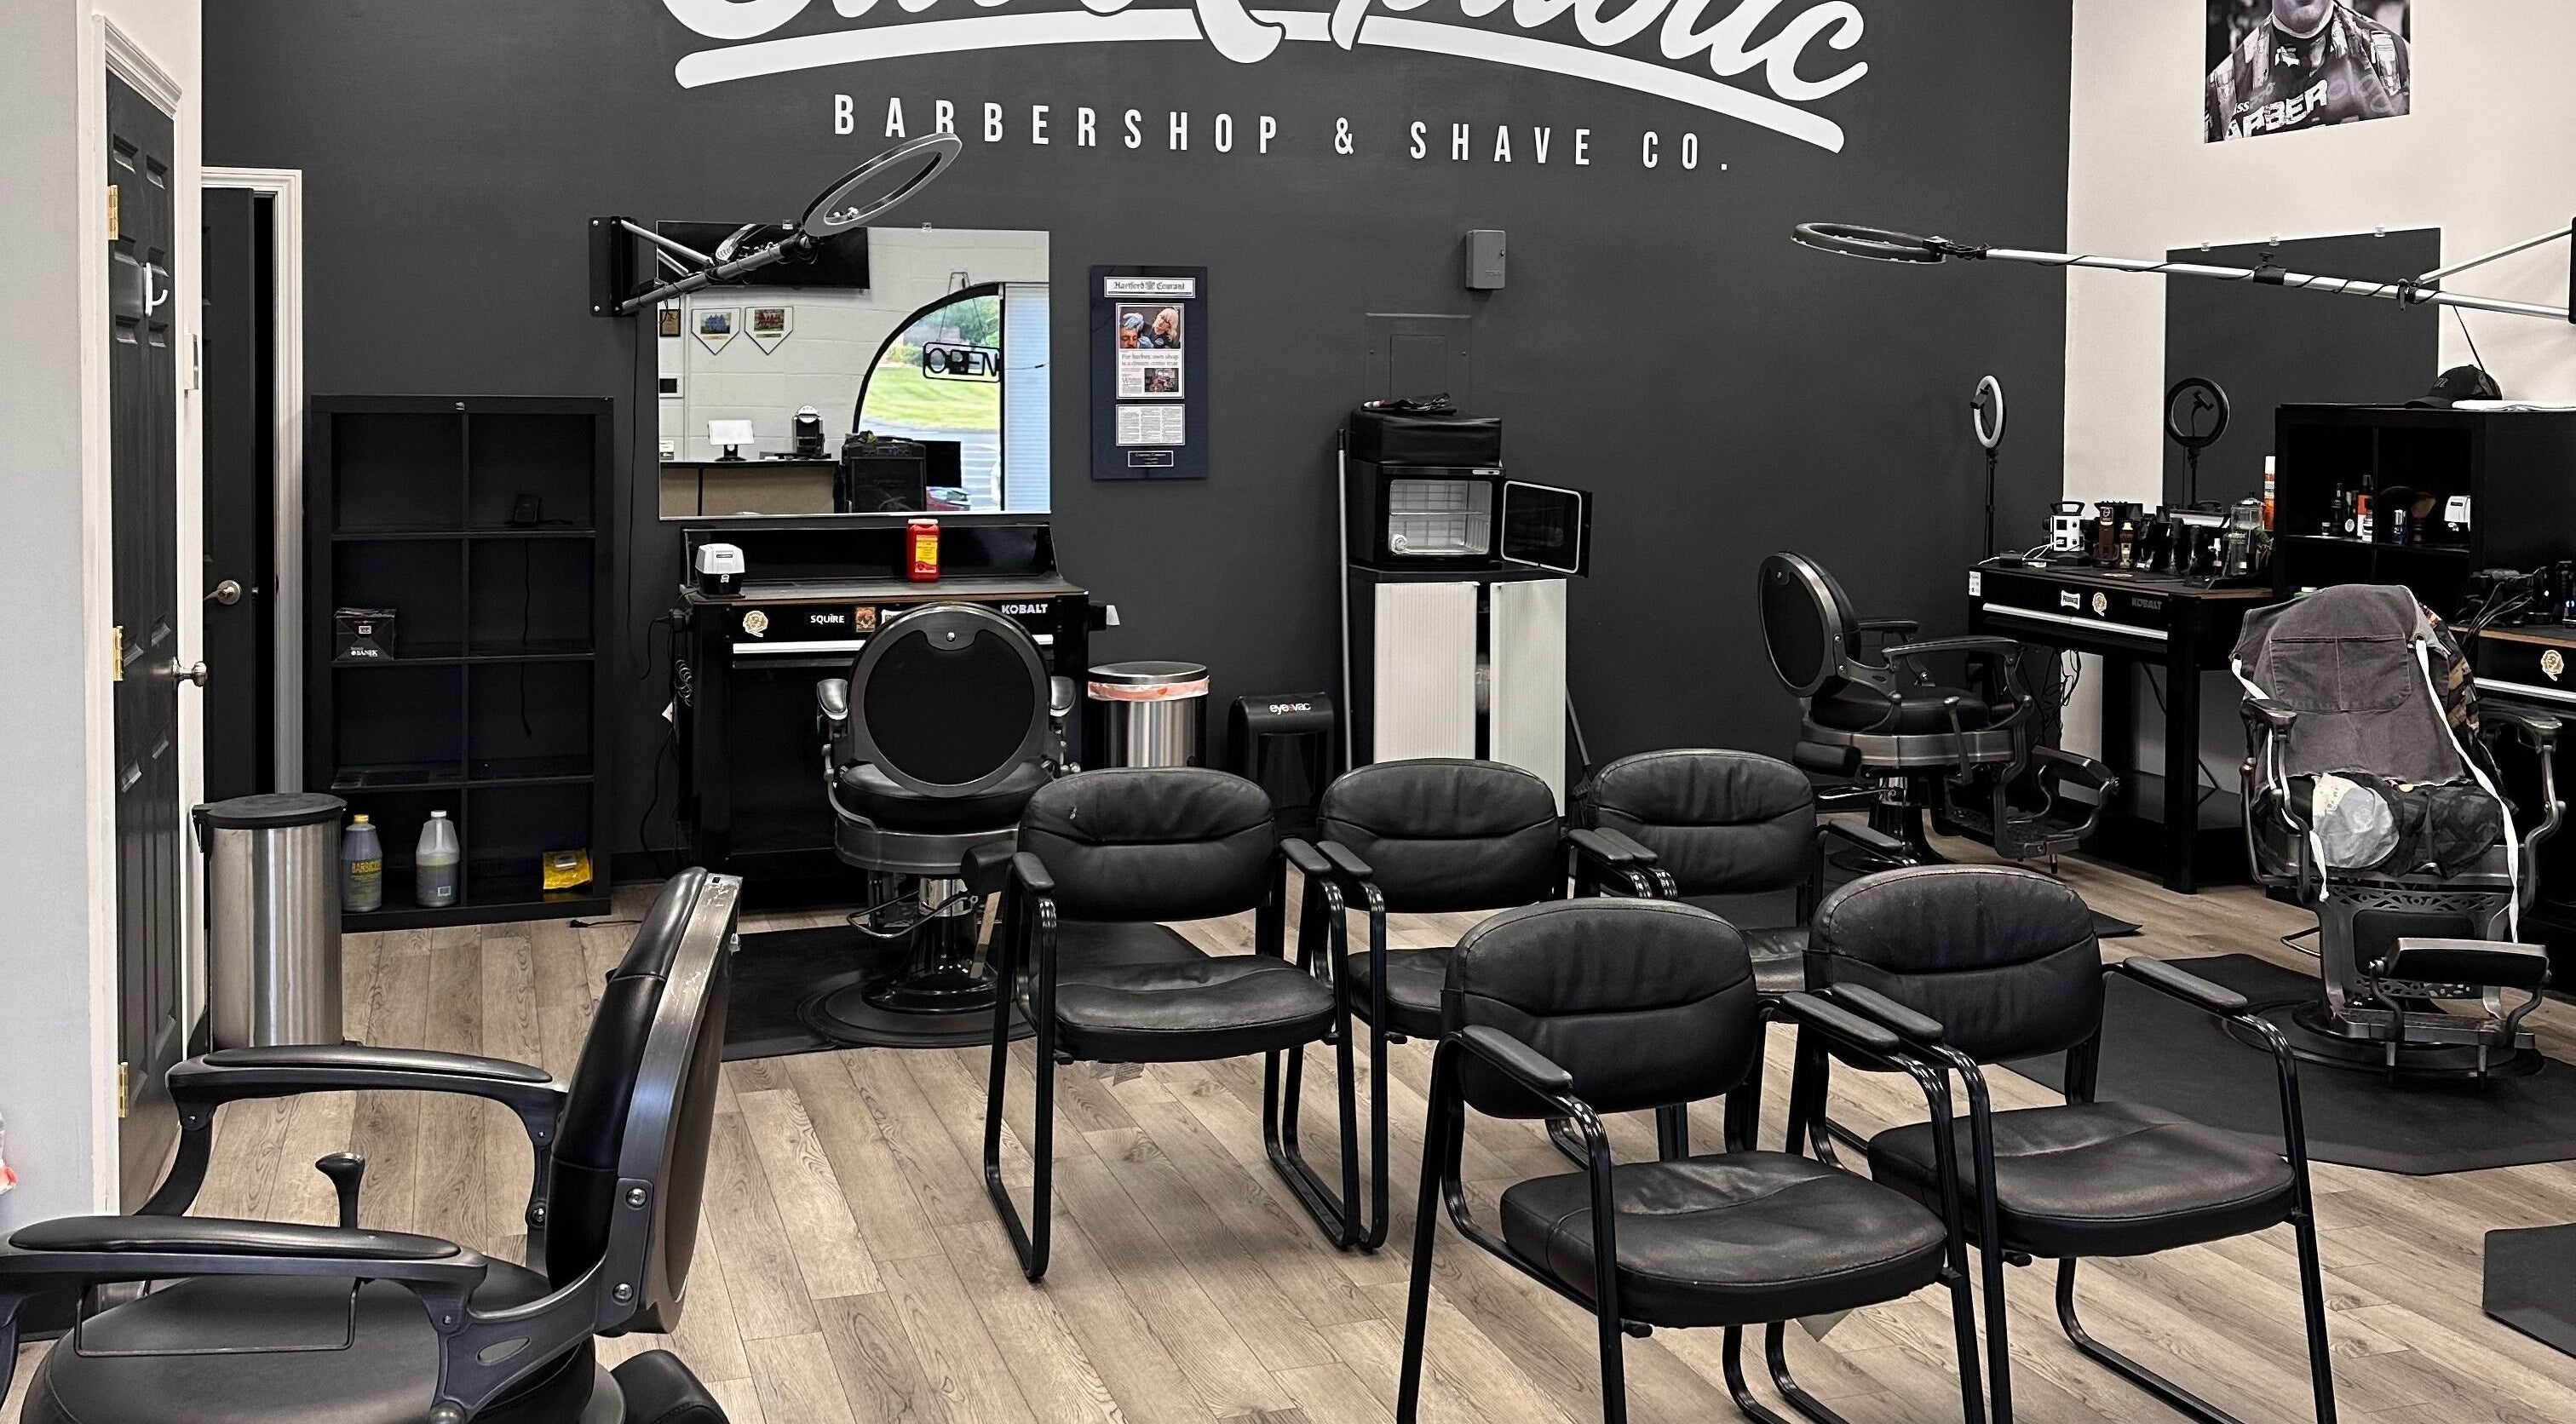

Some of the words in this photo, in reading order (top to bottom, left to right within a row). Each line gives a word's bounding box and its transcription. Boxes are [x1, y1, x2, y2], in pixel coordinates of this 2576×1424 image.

[834, 94, 1277, 154] BARBERSHOP
[1334, 117, 1354, 155] &
[1410, 121, 1590, 165] SHAVE
[1642, 131, 1728, 170] CO.
[929, 347, 998, 376] OPEN
[1001, 603, 1049, 615] KOBALT
[2131, 597, 2163, 611] KOBALT
[810, 613, 845, 625] SQUIRE
